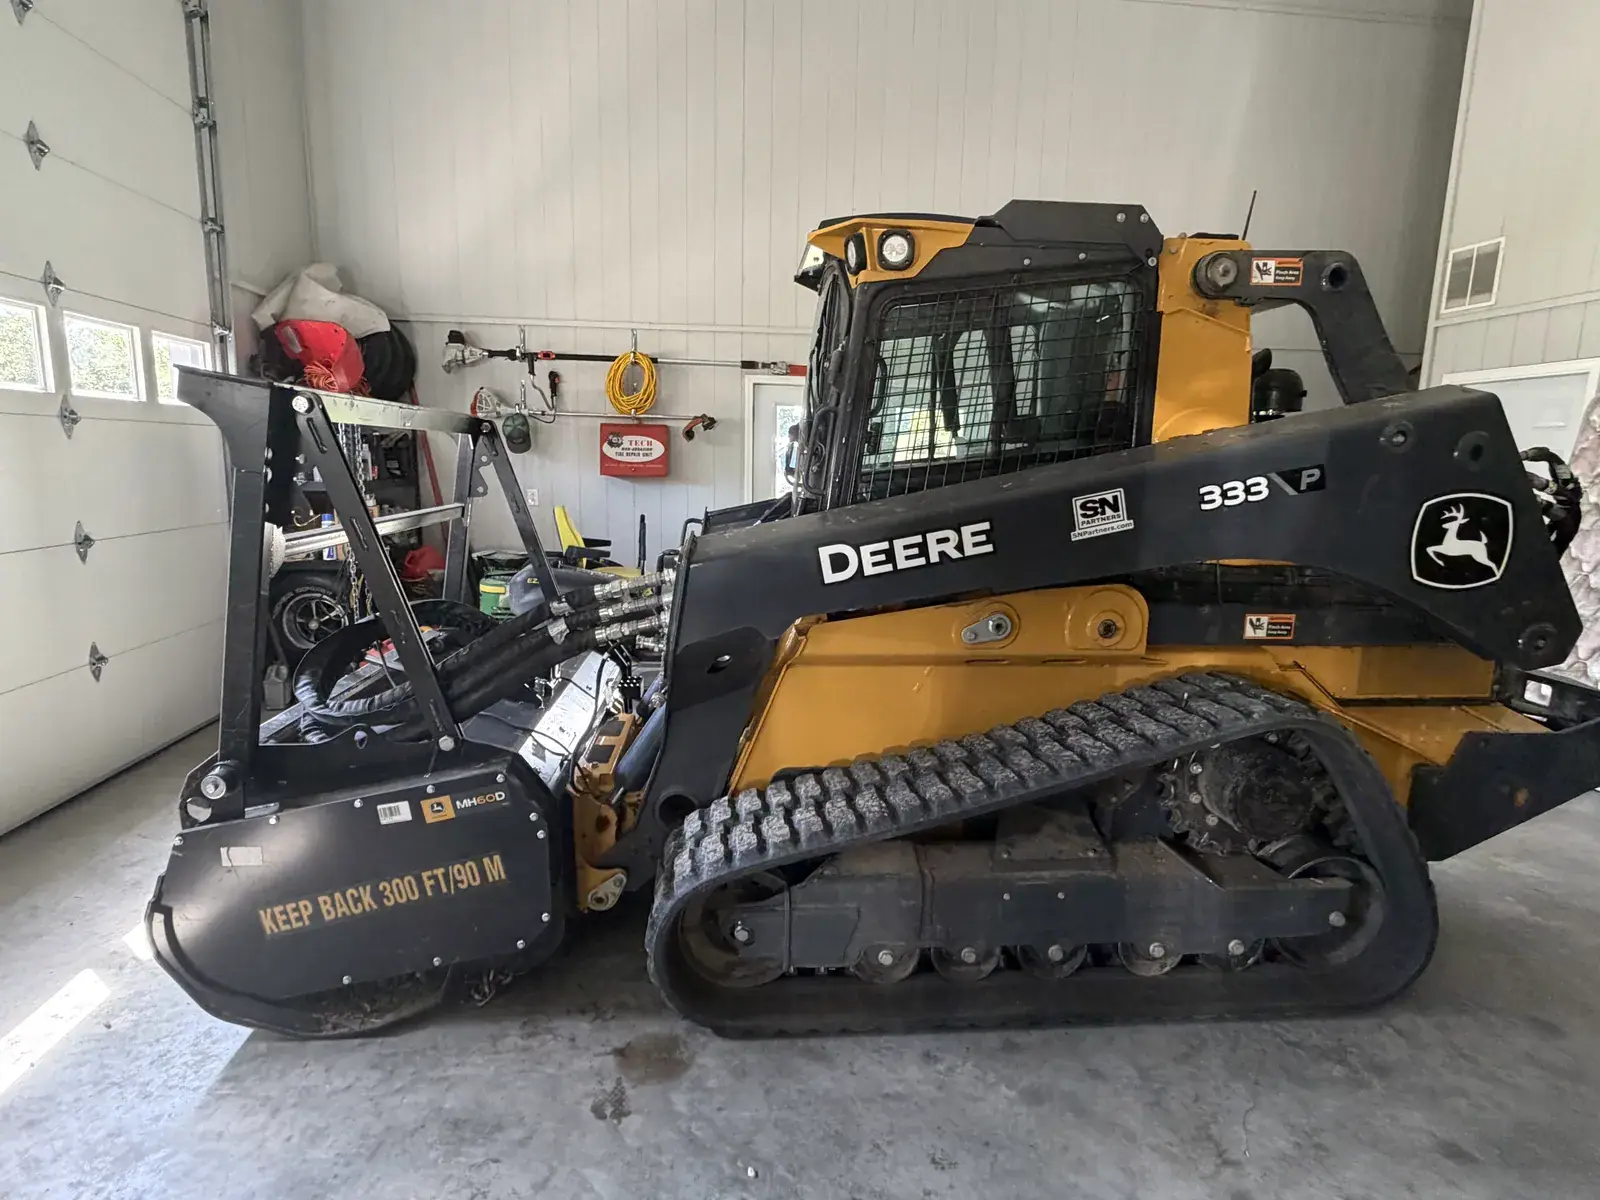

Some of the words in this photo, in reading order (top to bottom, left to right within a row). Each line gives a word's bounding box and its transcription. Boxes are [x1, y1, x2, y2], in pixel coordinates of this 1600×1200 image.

[1199, 476, 1270, 510] 333
[1080, 494, 1120, 519] SN
[1072, 522, 1133, 539] SNPartners.com
[1081, 513, 1121, 527] PARTNERS
[818, 521, 994, 584] DEERE
[456, 791, 506, 810] MH60D
[259, 900, 313, 935] KEEP
[317, 884, 378, 921] BACK
[379, 875, 419, 907] 300
[421, 861, 481, 896] FT/90
[483, 855, 506, 883] M
